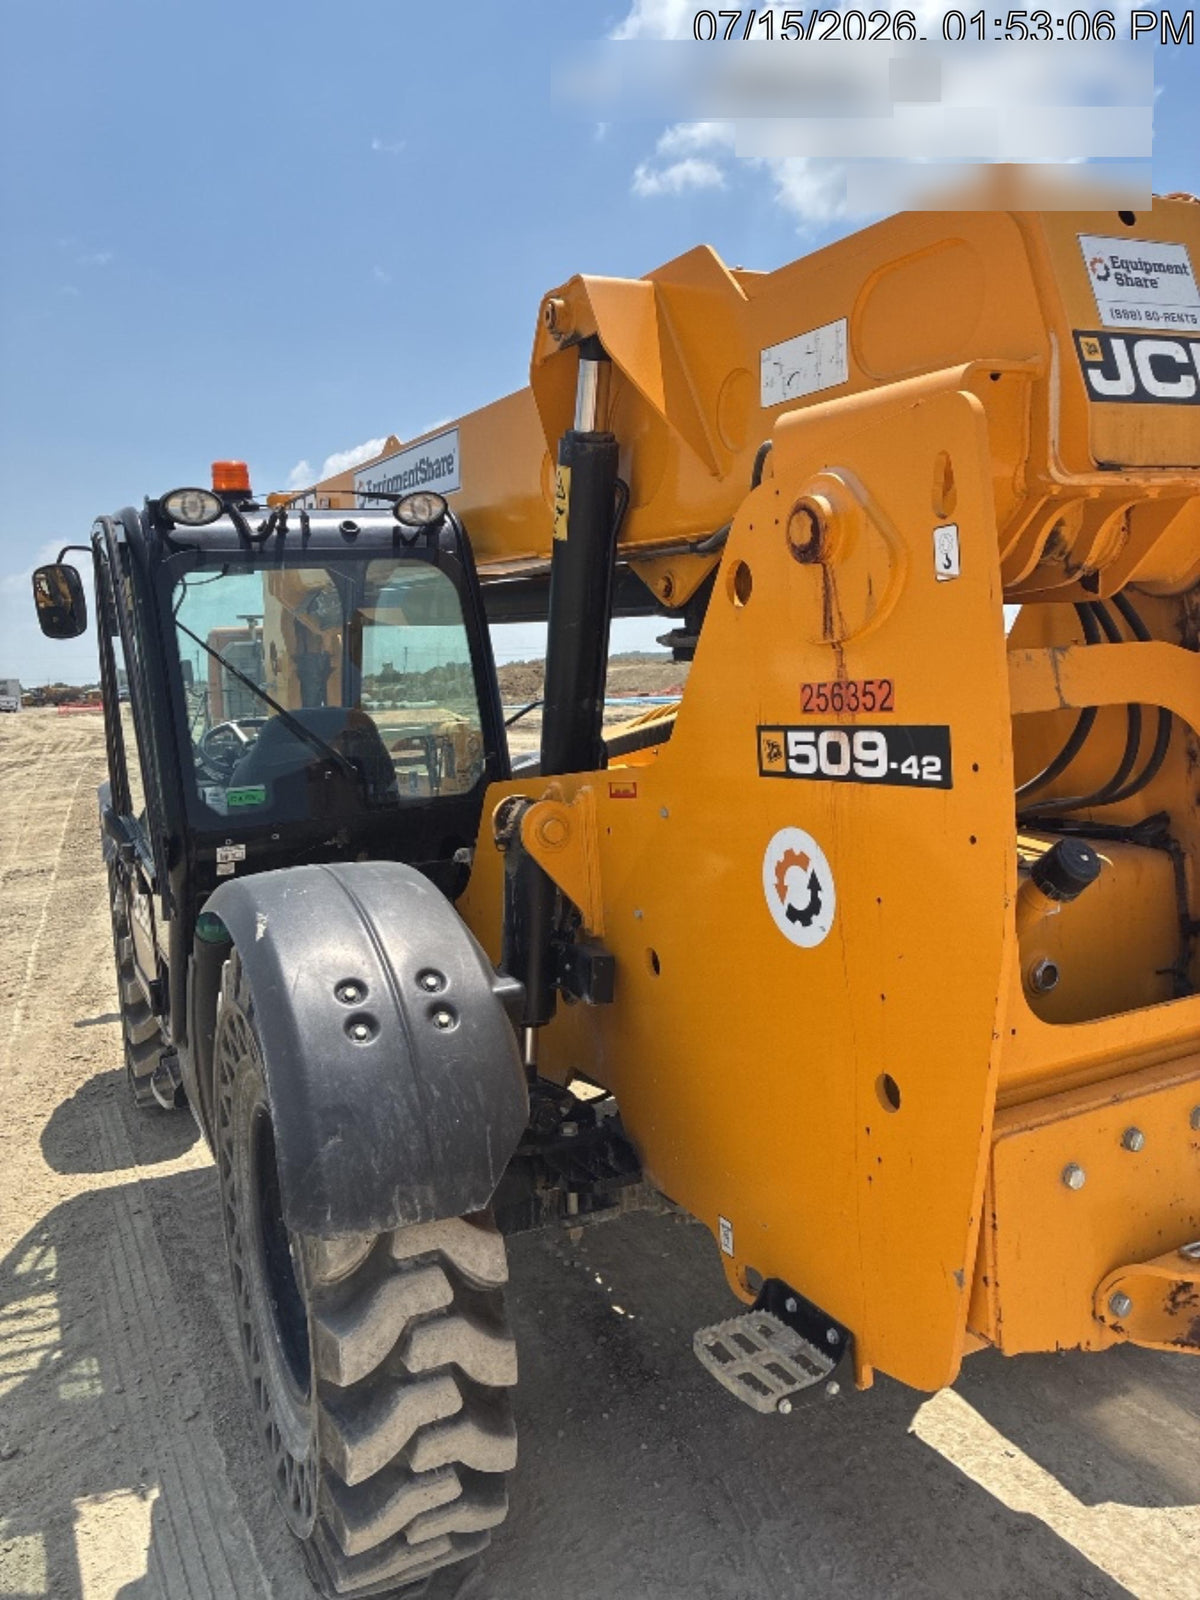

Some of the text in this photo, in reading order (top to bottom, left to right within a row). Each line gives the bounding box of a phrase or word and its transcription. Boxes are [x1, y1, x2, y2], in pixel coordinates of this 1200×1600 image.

[1109, 255, 1190, 276] Equipment
[1114, 273, 1159, 289] Share
[1109, 307, 1143, 321] (888)
[1087, 338, 1200, 398] JC
[801, 679, 893, 713] 256352
[787, 730, 943, 781] 509-42
